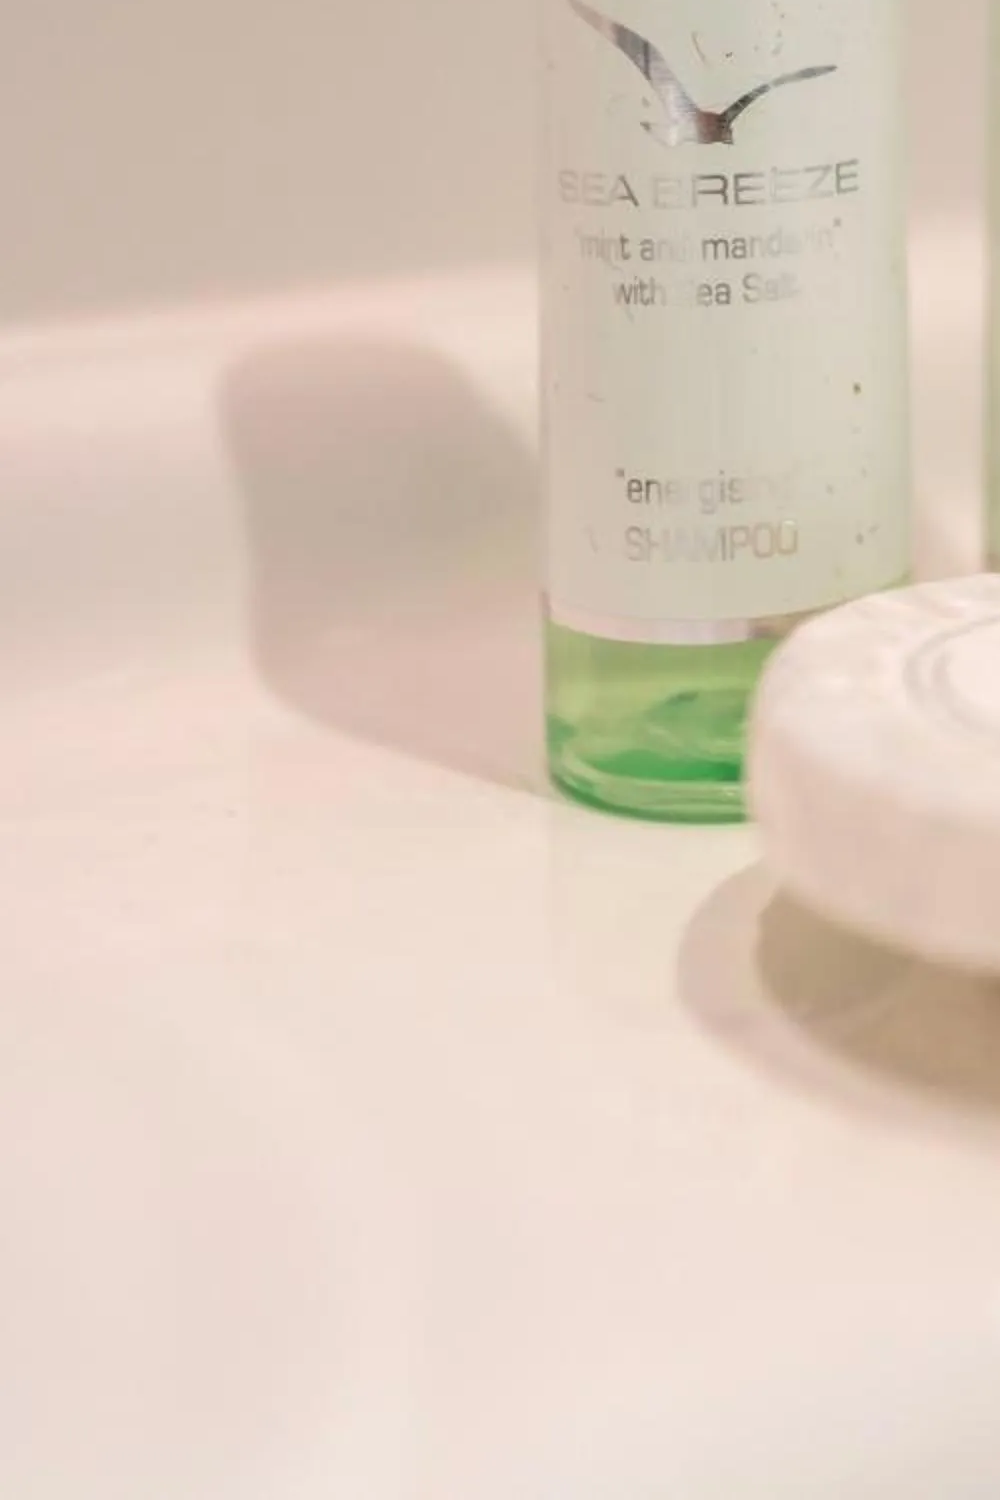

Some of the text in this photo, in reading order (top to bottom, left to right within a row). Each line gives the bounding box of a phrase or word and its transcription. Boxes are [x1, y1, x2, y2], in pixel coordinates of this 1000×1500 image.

[557, 167, 640, 208] SEA
[701, 215, 843, 262] mandain"
[611, 275, 668, 308] with
[676, 275, 732, 308] ea
